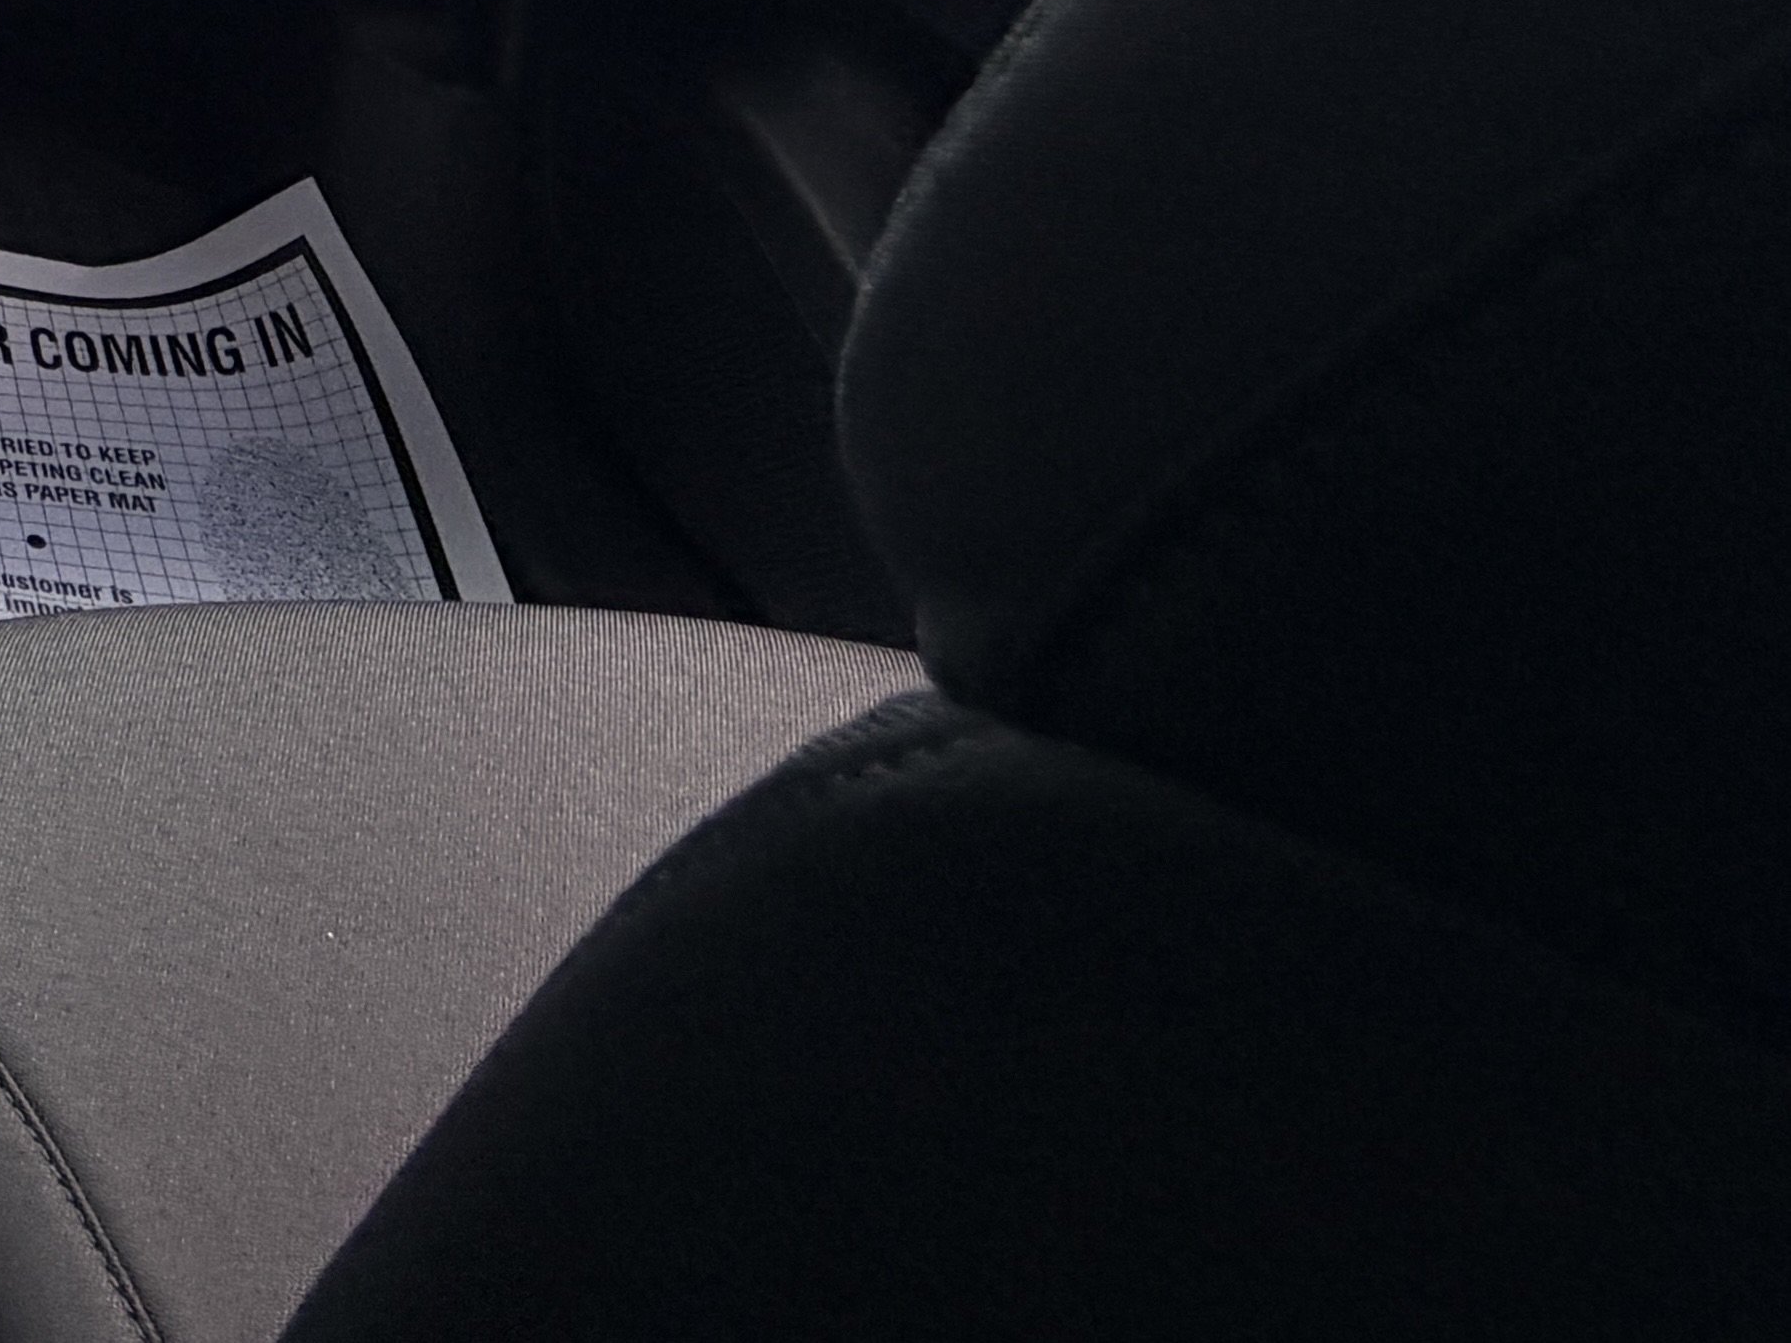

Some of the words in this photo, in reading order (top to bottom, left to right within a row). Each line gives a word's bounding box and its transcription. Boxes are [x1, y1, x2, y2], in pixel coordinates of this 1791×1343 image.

[31, 326, 246, 377] COMING
[253, 304, 314, 369] IN
[60, 442, 91, 461] TO
[99, 447, 156, 467] KEEP
[90, 467, 166, 491] CLEAN
[24, 484, 102, 508] PAPER
[108, 491, 157, 513] MAT
[112, 585, 133, 604] is
